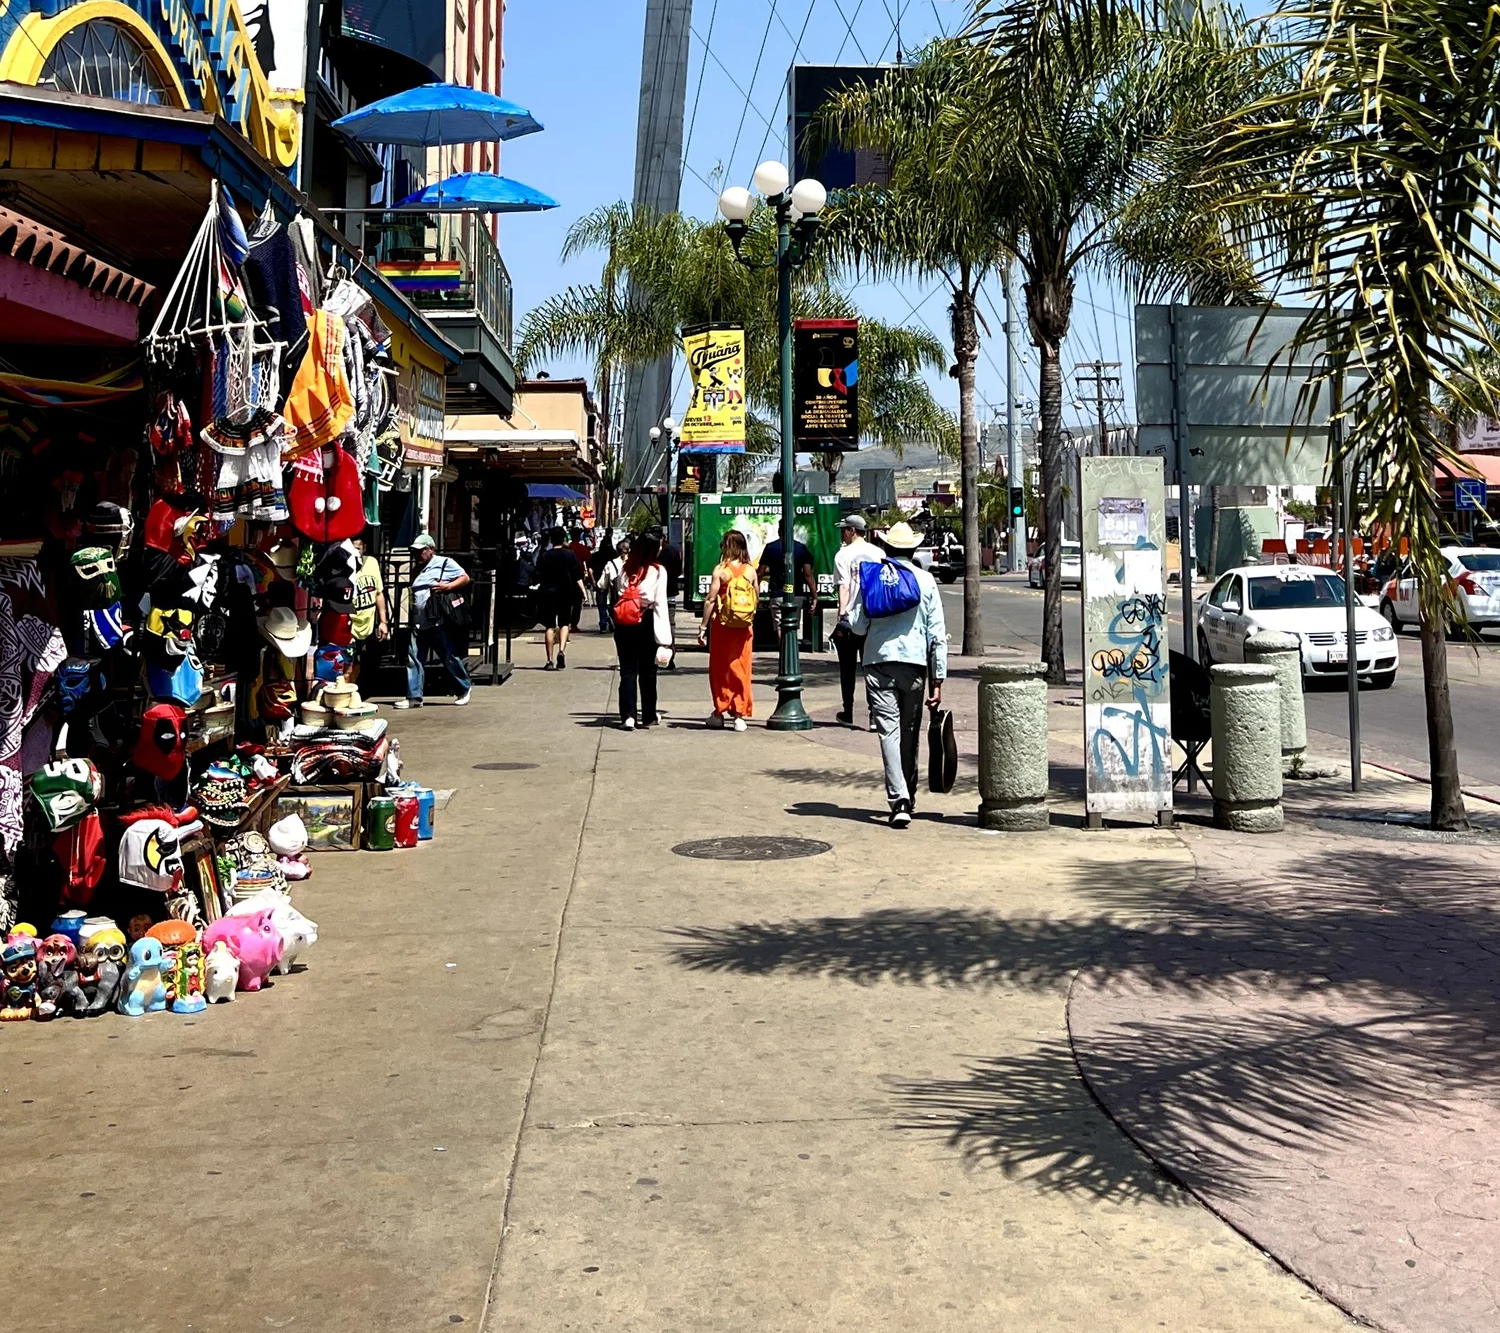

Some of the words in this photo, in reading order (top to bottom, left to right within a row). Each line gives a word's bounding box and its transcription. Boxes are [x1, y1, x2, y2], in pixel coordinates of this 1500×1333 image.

[720, 506, 732, 515] TE
[735, 506, 782, 515] INVITAMOS
[796, 506, 815, 515] QUE
